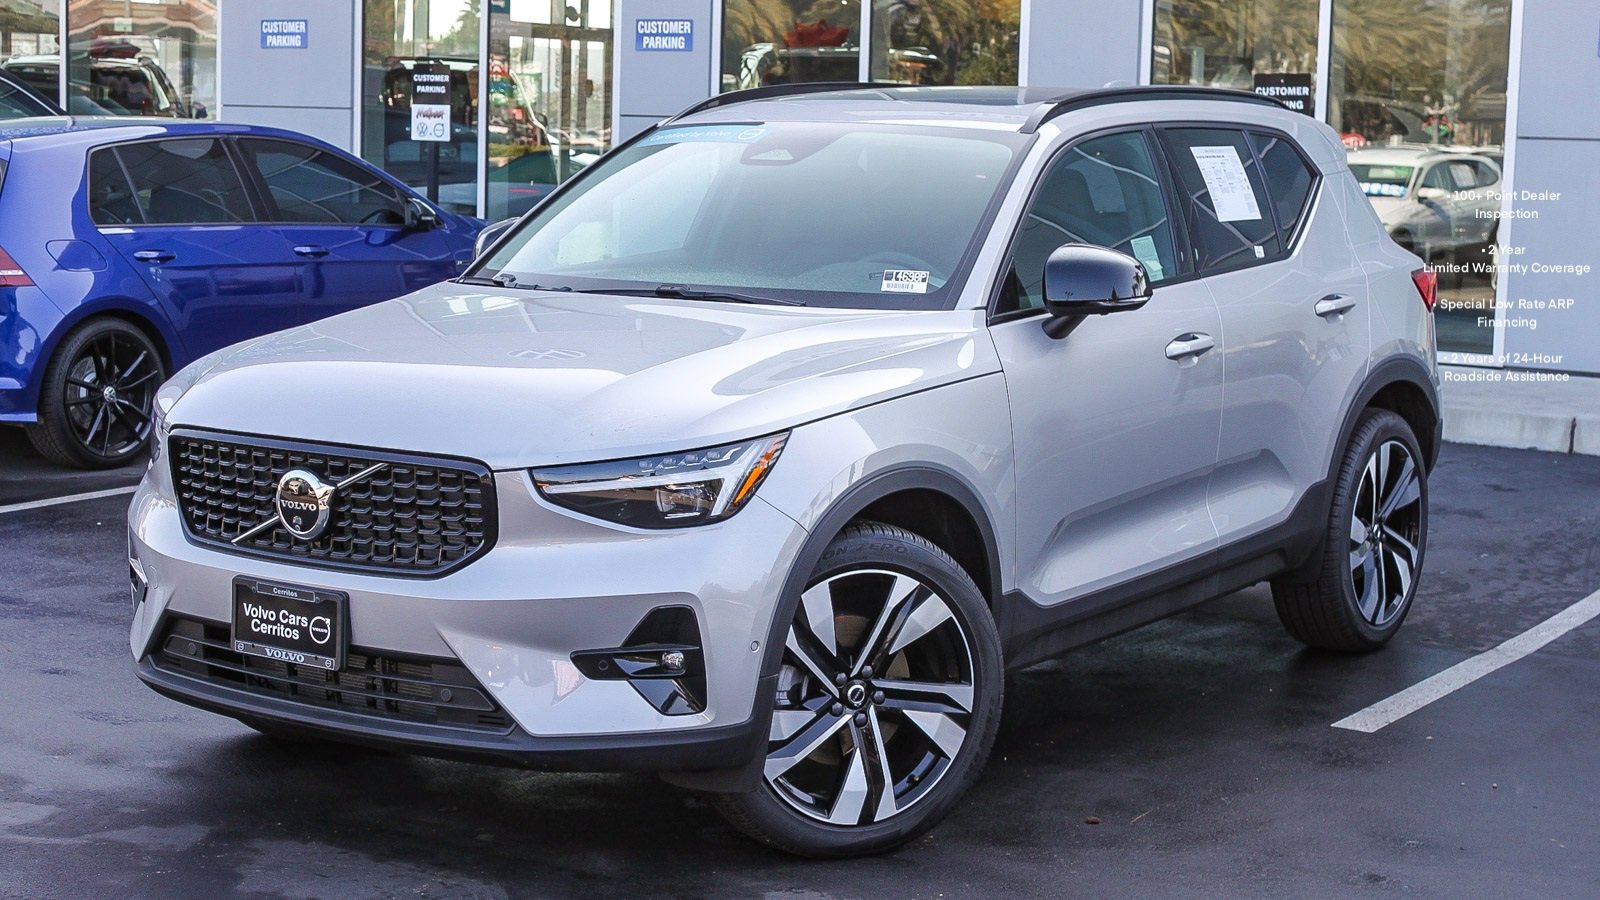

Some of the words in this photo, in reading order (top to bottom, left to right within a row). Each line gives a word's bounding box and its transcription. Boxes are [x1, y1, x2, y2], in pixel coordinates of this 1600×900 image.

[262, 21, 306, 33] CUSTOMER
[637, 20, 691, 34] CUSTOMER
[266, 35, 301, 47] PARKING
[642, 35, 685, 49] PARKING
[413, 74, 450, 82] CUSTOMER
[416, 85, 446, 94] PARKING
[1255, 86, 1309, 96] CUSTOMER
[281, 499, 317, 512] VOLVO
[272, 587, 298, 598] Cerritos
[243, 602, 276, 621] Volvo
[279, 609, 308, 627] Cars
[251, 619, 300, 640] Cerritos
[264, 647, 305, 663] VOLVO
